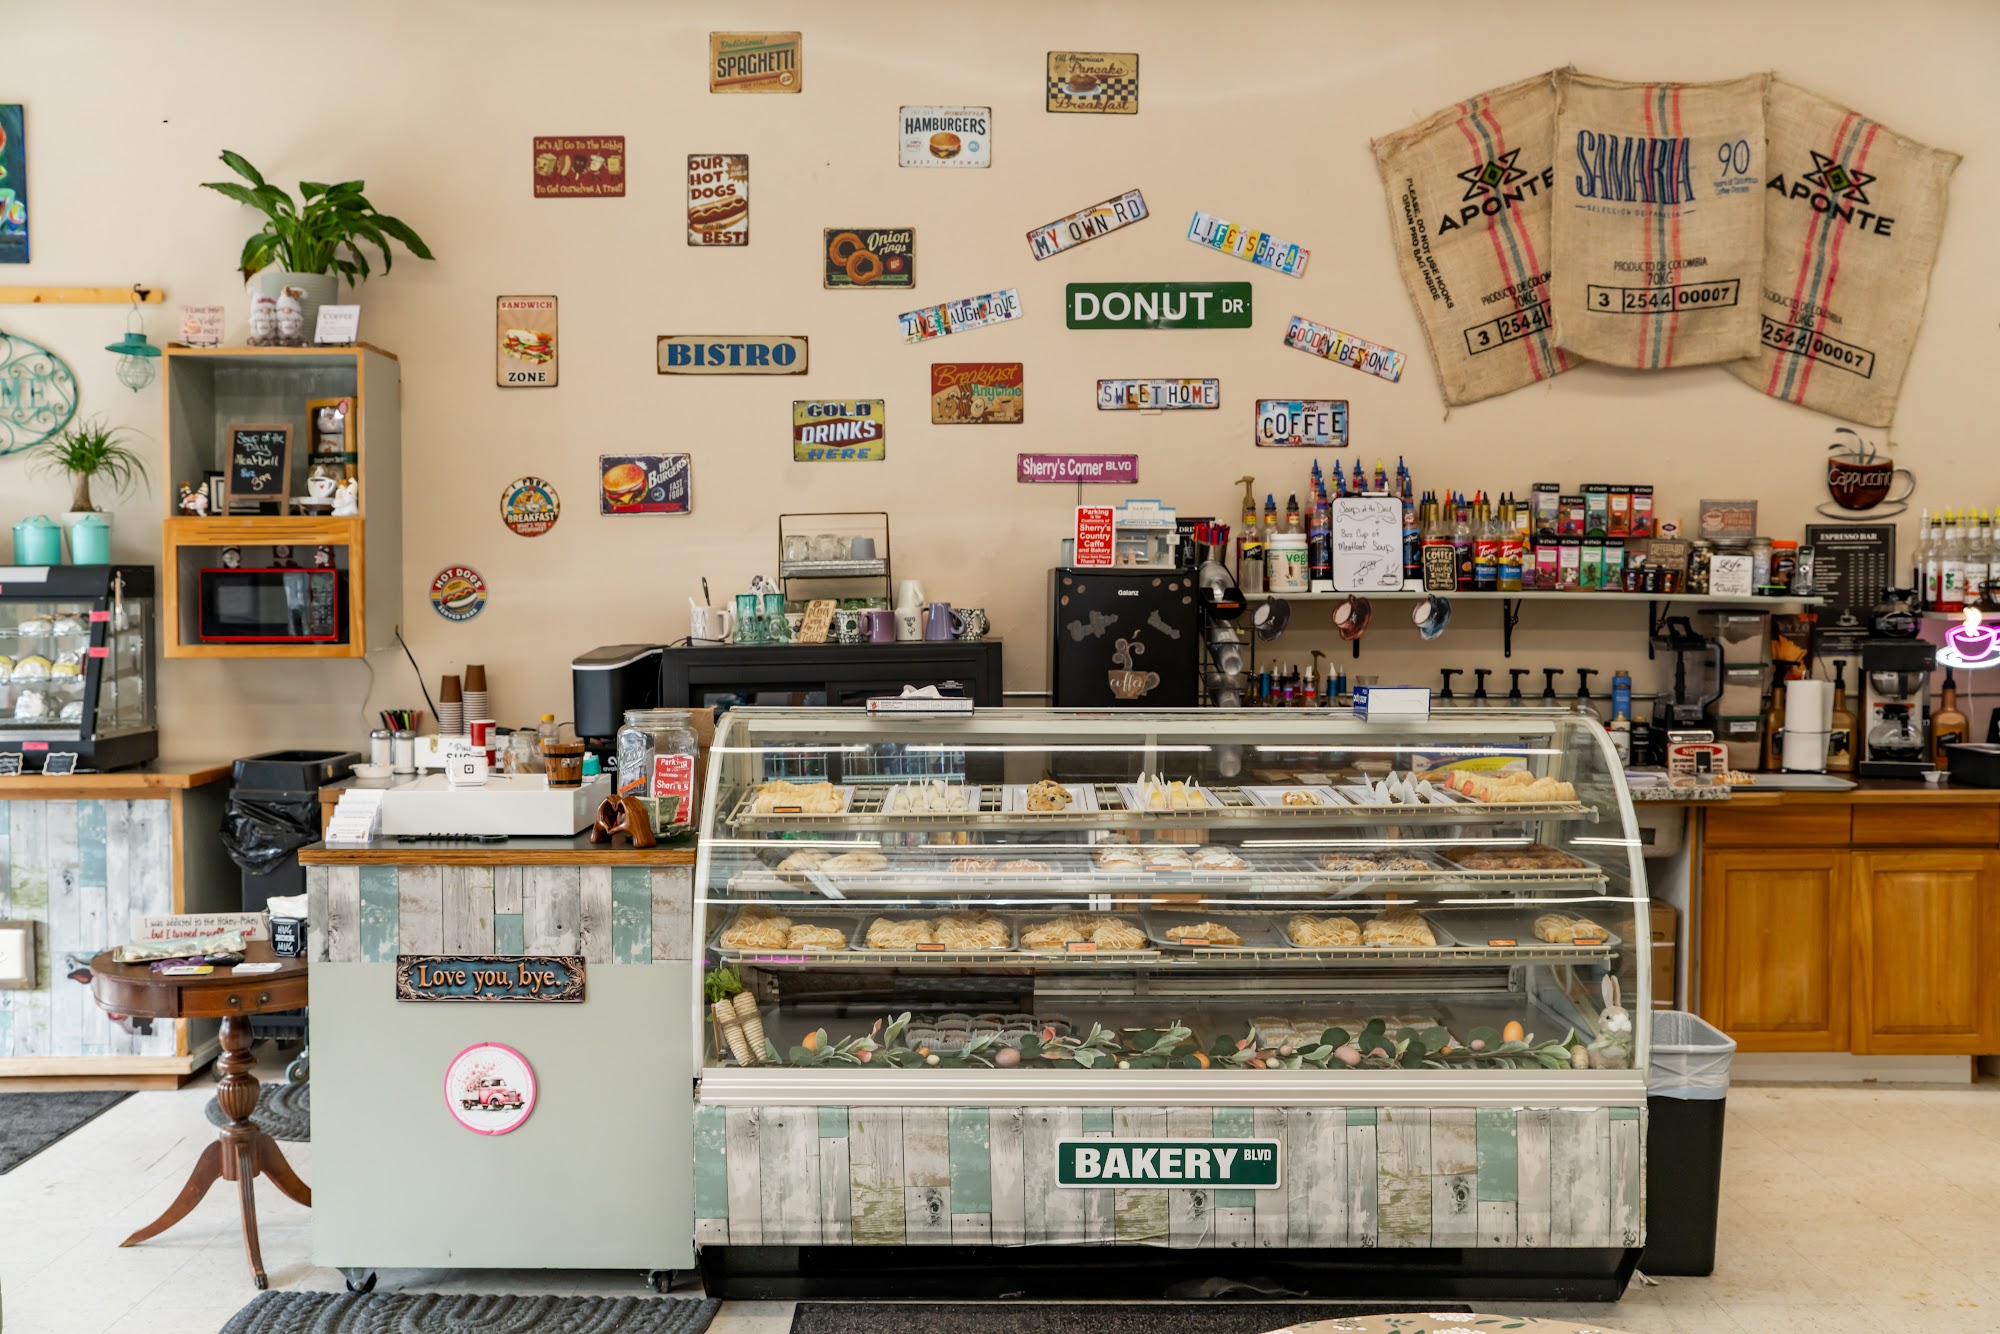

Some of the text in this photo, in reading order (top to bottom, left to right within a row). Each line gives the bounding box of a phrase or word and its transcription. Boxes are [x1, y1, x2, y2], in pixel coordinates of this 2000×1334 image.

[717, 49, 794, 78] SPAGHETTI
[1069, 54, 1104, 62] American
[1069, 62, 1124, 74] Pancake
[1055, 98, 1129, 112] Breakfast
[905, 117, 986, 136] HAMBURGERS
[536, 140, 623, 152] Let's All Go To The Lobby
[689, 156, 723, 171] OUR
[1718, 140, 1750, 177] 90
[1576, 130, 1696, 204] SAMARIA
[690, 171, 723, 186] HOT
[536, 184, 546, 192] To
[547, 184, 560, 192] Get
[560, 182, 594, 192] Ourselves
[596, 184, 602, 194] A
[691, 184, 736, 200] DOGS
[1438, 167, 1553, 236] APONTE
[1766, 174, 1896, 236] APONTE
[1034, 228, 1059, 257] MY
[1068, 214, 1108, 240] OWN
[1114, 200, 1140, 222] RD
[867, 231, 911, 251] Onion
[1402, 194, 1440, 301] GRAIN PRO BAG INSIDE
[1406, 178, 1454, 309] PLEASE, DO NOT USE HOOKS
[879, 244, 906, 255] rings
[1614, 256, 1708, 272] PRODUCTO DE COLOMBIA
[1648, 272, 1674, 286] 70KG
[1481, 285, 1518, 306] PRODUCTO
[1513, 292, 1538, 308] 70KG
[1598, 288, 1730, 309] 3 2544 00007
[943, 306, 980, 326] LAUGH
[988, 295, 1017, 317] LOVE
[1074, 292, 1244, 321] DONUT DR
[1812, 304, 1843, 325] COLOMBIA
[1789, 310, 1814, 328] 70KG
[1478, 311, 1543, 346] 3 2544
[1288, 324, 1398, 374] GOOD VIBES ONLY
[1763, 322, 1866, 368] 2544 00007
[668, 343, 796, 366] BISTRO
[508, 372, 546, 382] ZONE
[934, 364, 1018, 387] Breakfast
[972, 384, 1022, 402] Anytime
[1104, 384, 1214, 404] SWEET HOME
[808, 402, 871, 417] COLD
[802, 420, 876, 444] DRINKS
[1264, 412, 1344, 438] COFFEE
[237, 432, 260, 444] Soup
[808, 448, 871, 460] HERE
[658, 457, 674, 472] HOT
[1023, 458, 1132, 480] Sherry's Corner BLVD
[1083, 508, 1109, 516] Parking
[1339, 501, 1360, 515] Soup
[508, 512, 556, 522] BREAKFAST
[1080, 524, 1111, 532] Sherry's
[1356, 528, 1369, 540] Cup
[1372, 529, 1380, 537] of
[1080, 532, 1110, 541] Country
[1084, 540, 1104, 548] Caffe
[1338, 540, 1394, 554] Meatloaf Soup
[1426, 552, 1453, 560] COFFEE
[1720, 560, 1742, 572] Life
[435, 570, 453, 588] HOT
[456, 568, 482, 588] DOGS
[1110, 672, 1145, 692] coffee
[166, 918, 192, 926] addicted
[195, 918, 202, 926] to
[204, 918, 214, 926] the
[218, 916, 258, 926] Hokey-Pokey
[172, 928, 198, 939] turned
[278, 925, 292, 936] HUG
[277, 942, 294, 952] MUG
[418, 962, 562, 994] Love you, bye.
[1075, 1147, 1272, 1179] BAKERY BLVD
